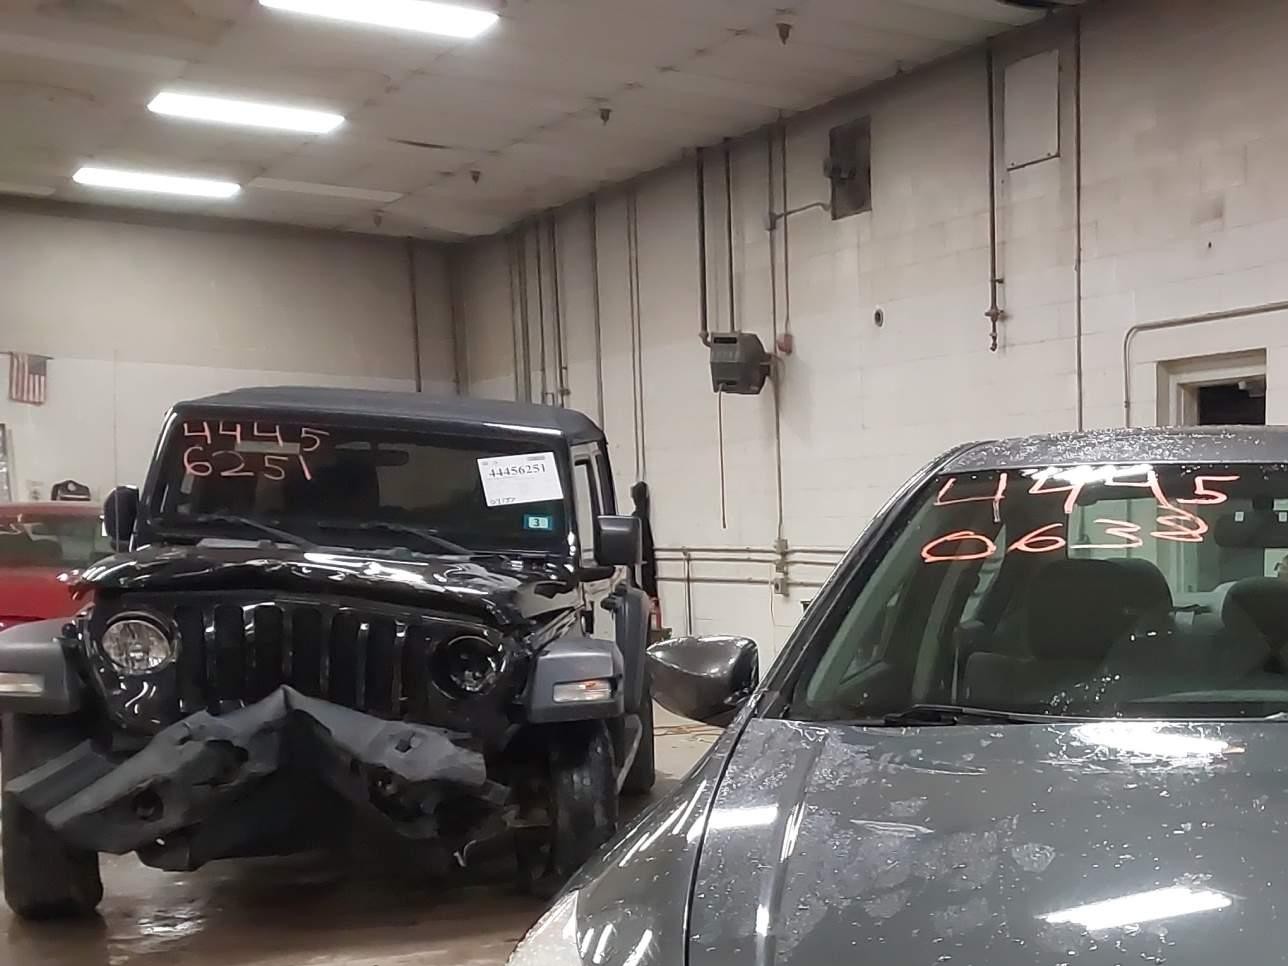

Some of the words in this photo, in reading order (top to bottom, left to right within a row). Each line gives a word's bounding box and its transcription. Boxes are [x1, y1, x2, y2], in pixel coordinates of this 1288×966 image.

[184, 421, 330, 452] 4445
[184, 445, 312, 480] 6251
[488, 463, 547, 478] 44456251
